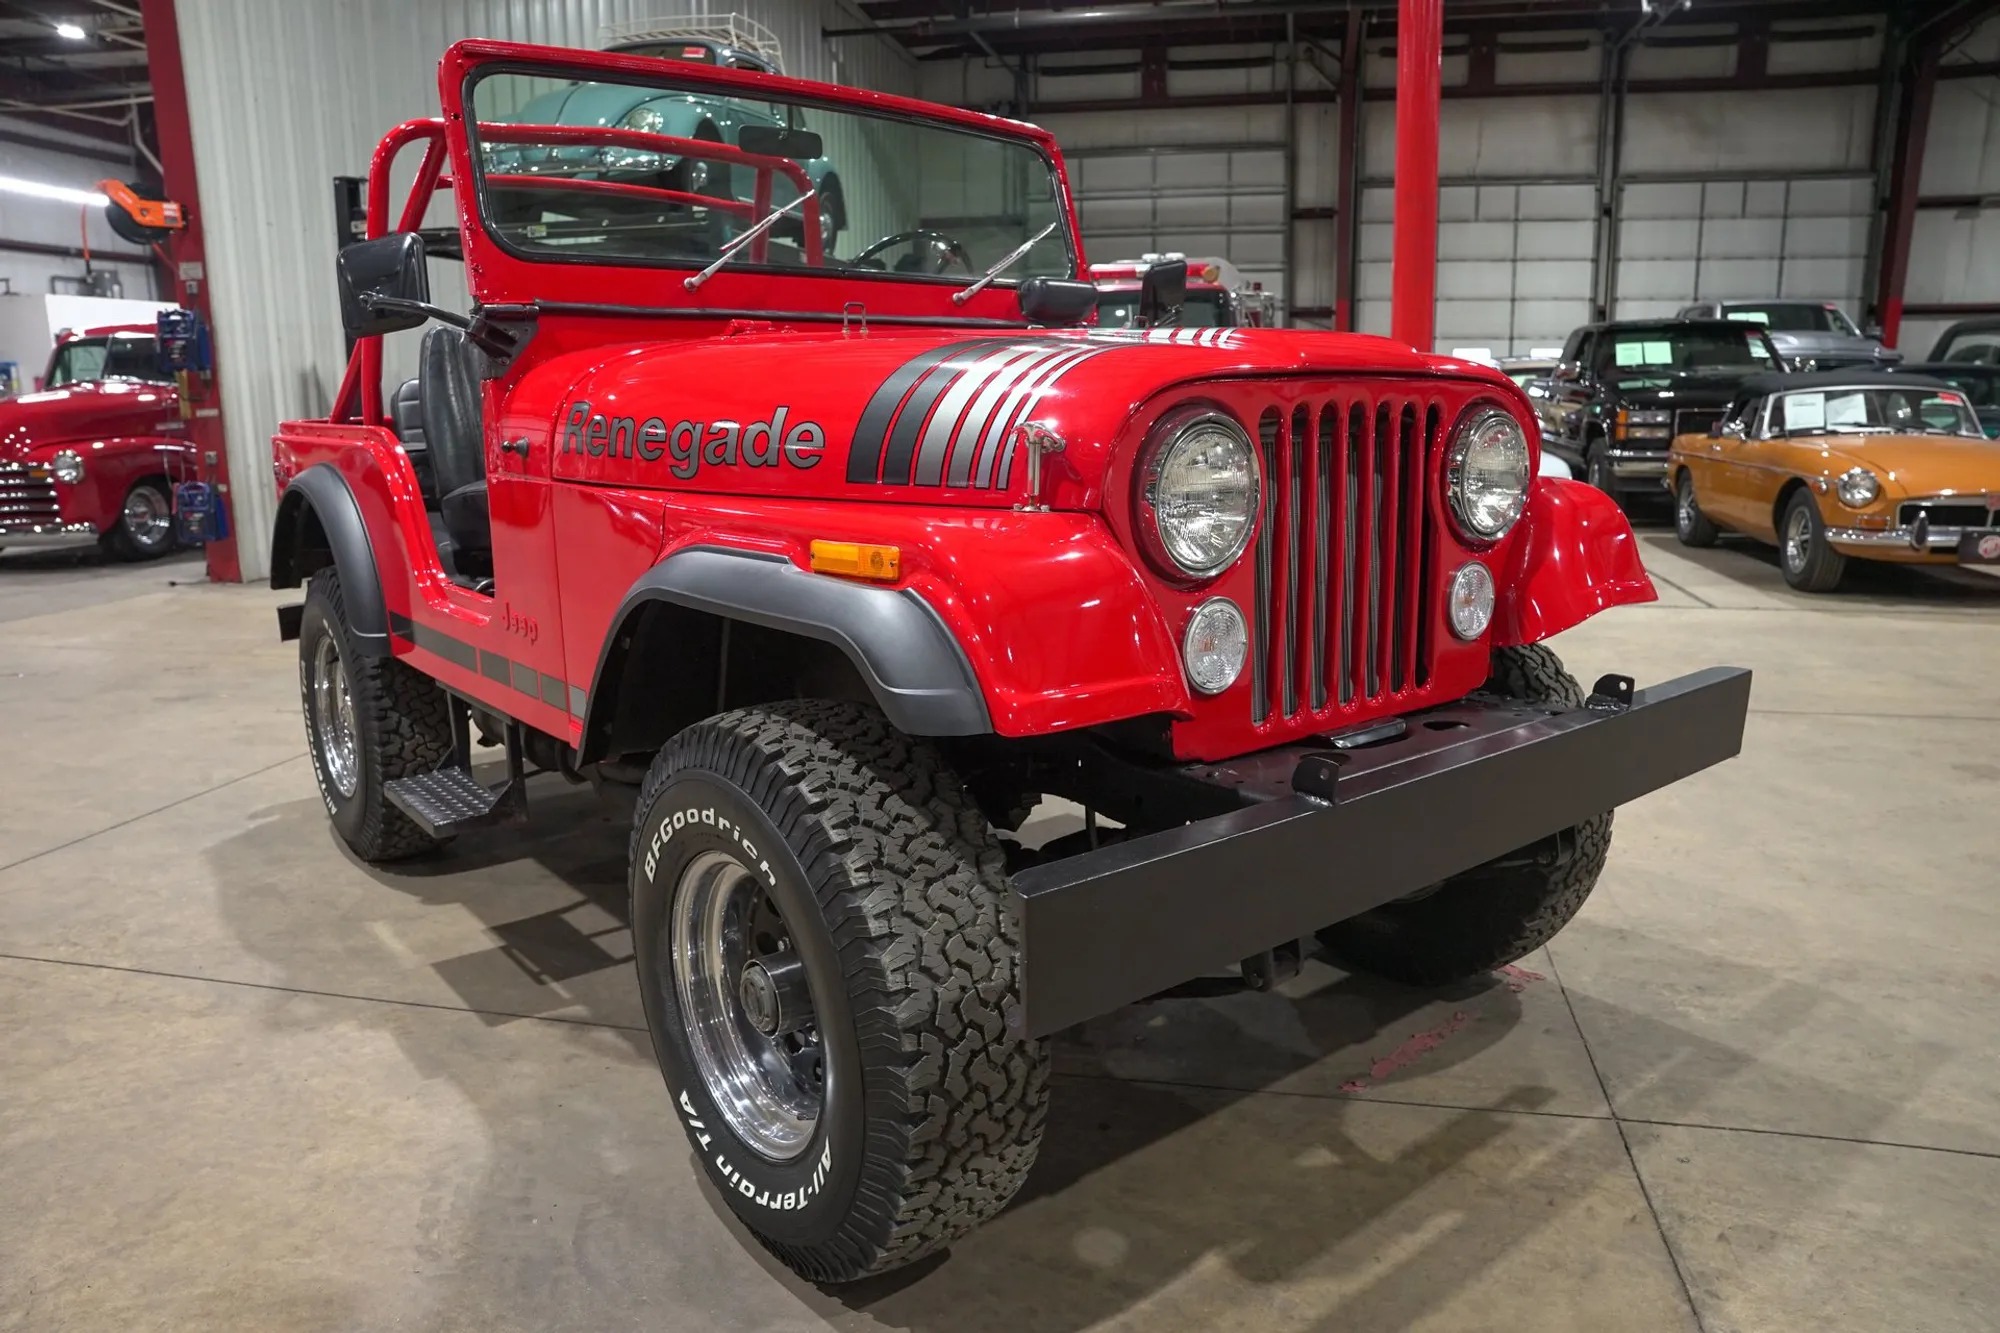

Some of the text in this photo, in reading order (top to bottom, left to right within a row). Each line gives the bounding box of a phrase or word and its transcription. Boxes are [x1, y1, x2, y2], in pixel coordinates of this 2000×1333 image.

[562, 401, 825, 480] Renegade
[502, 600, 538, 647] Jeep
[644, 807, 776, 887] BFGoodrich
[679, 1090, 832, 1210] All-Terrain T/A
